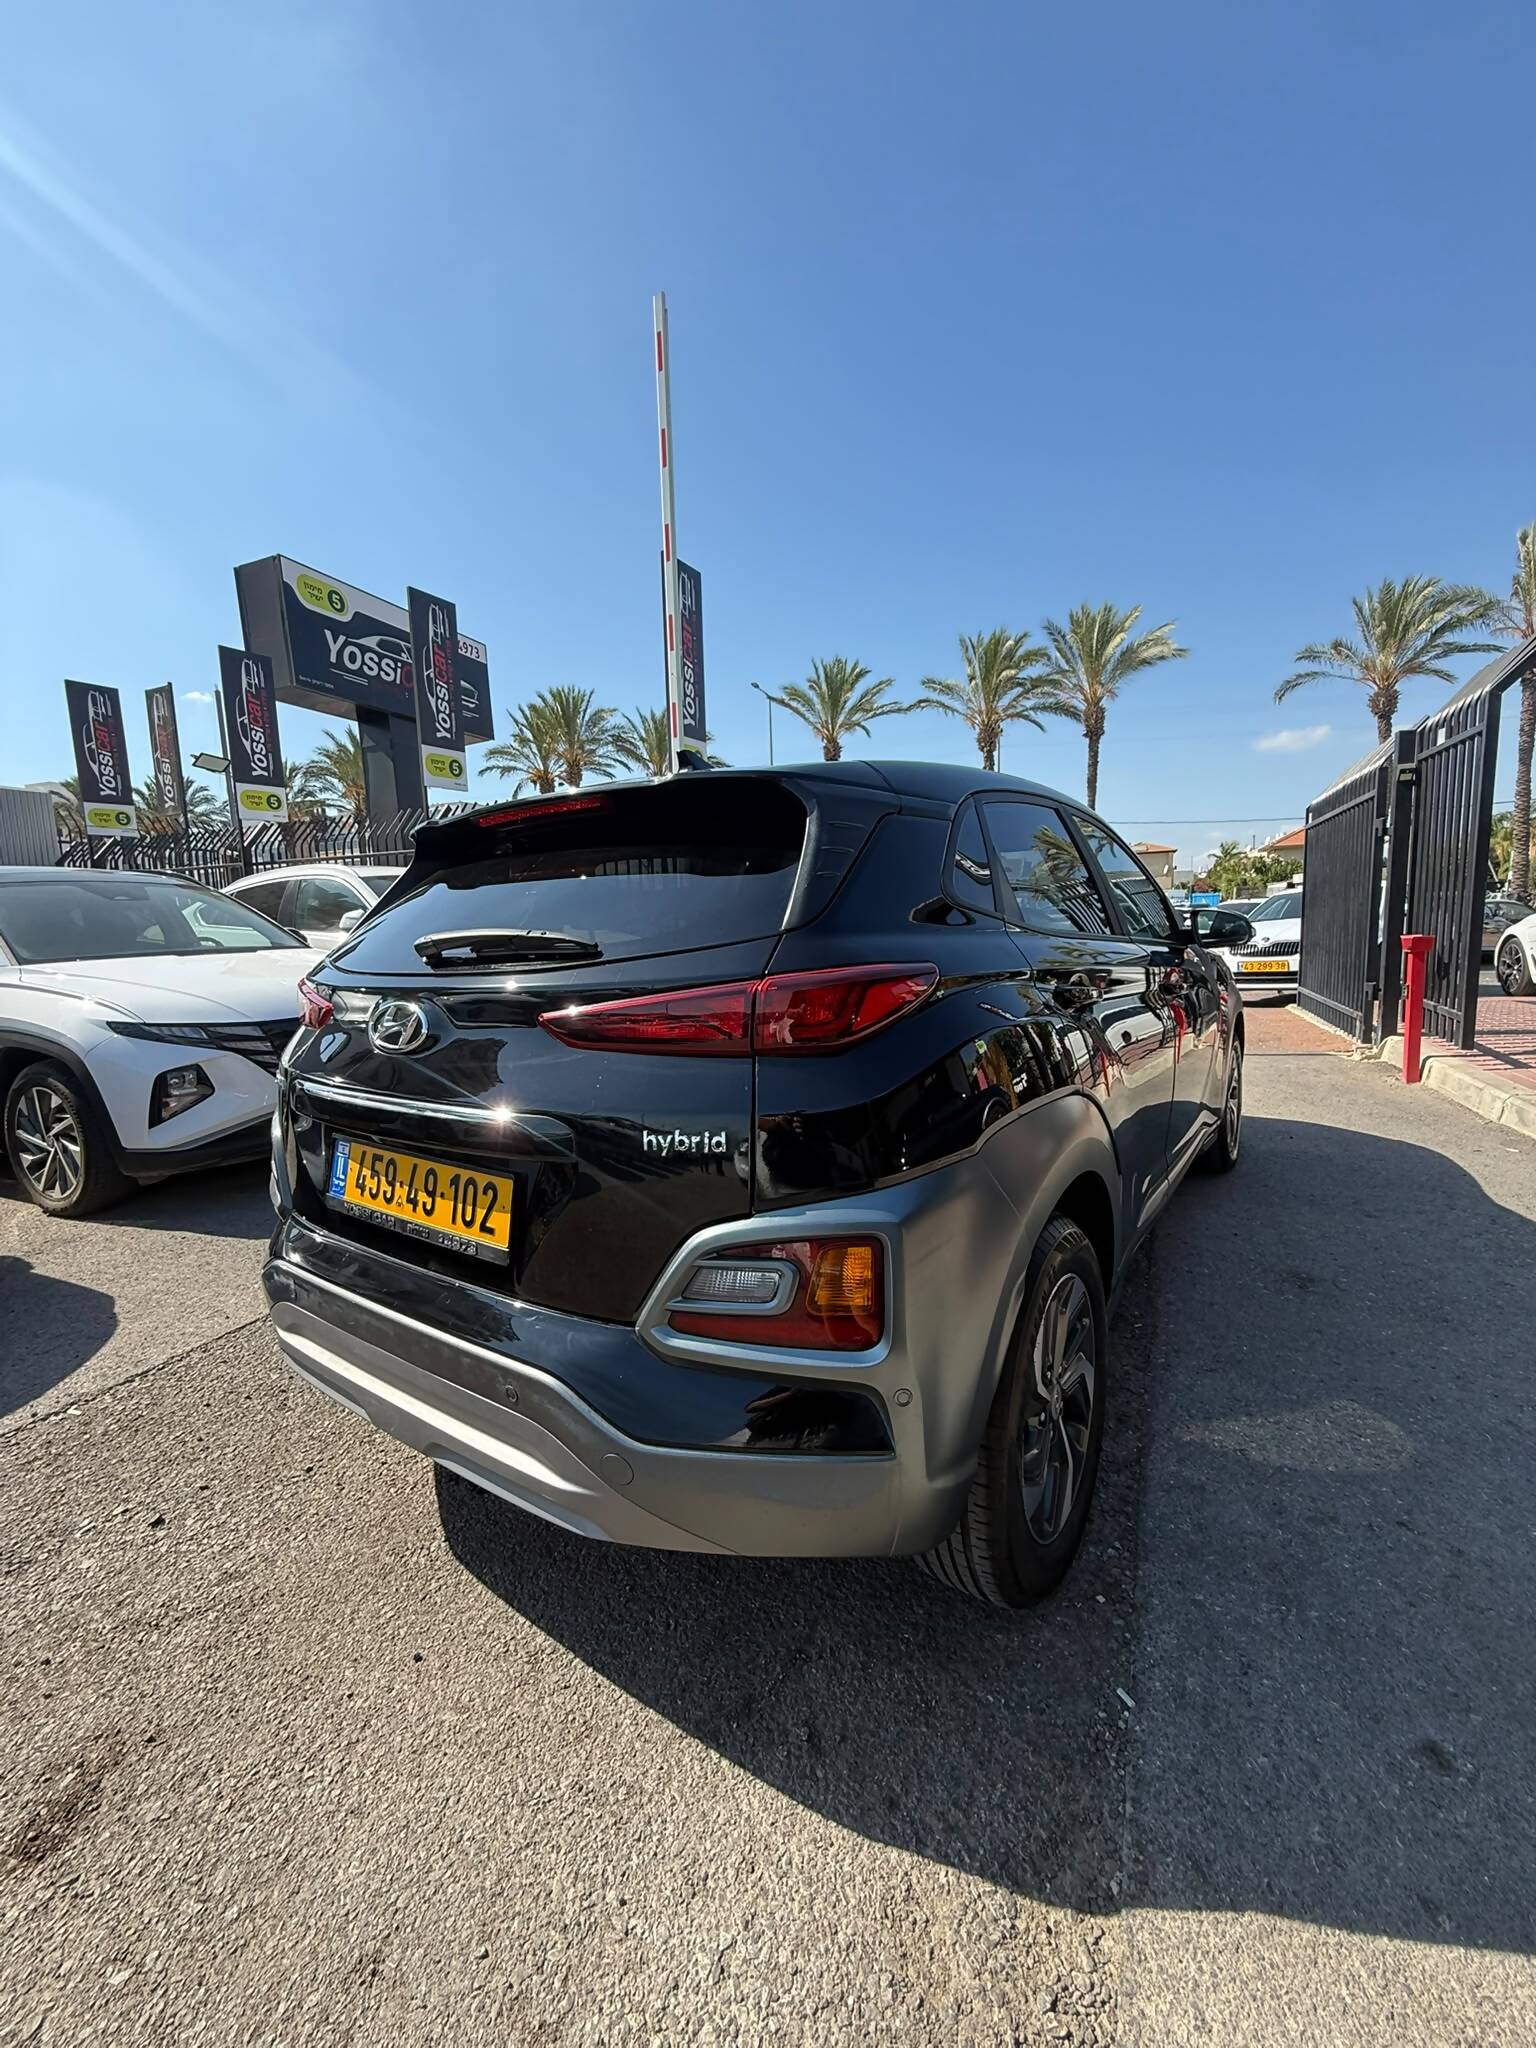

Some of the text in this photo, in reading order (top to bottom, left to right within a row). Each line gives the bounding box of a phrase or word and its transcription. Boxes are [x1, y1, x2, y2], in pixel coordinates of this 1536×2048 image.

[331, 593, 342, 610] 5
[452, 762, 460, 774] 5
[270, 797, 279, 808] 5
[118, 814, 128, 824] 5
[643, 1129, 727, 1157] hybrid
